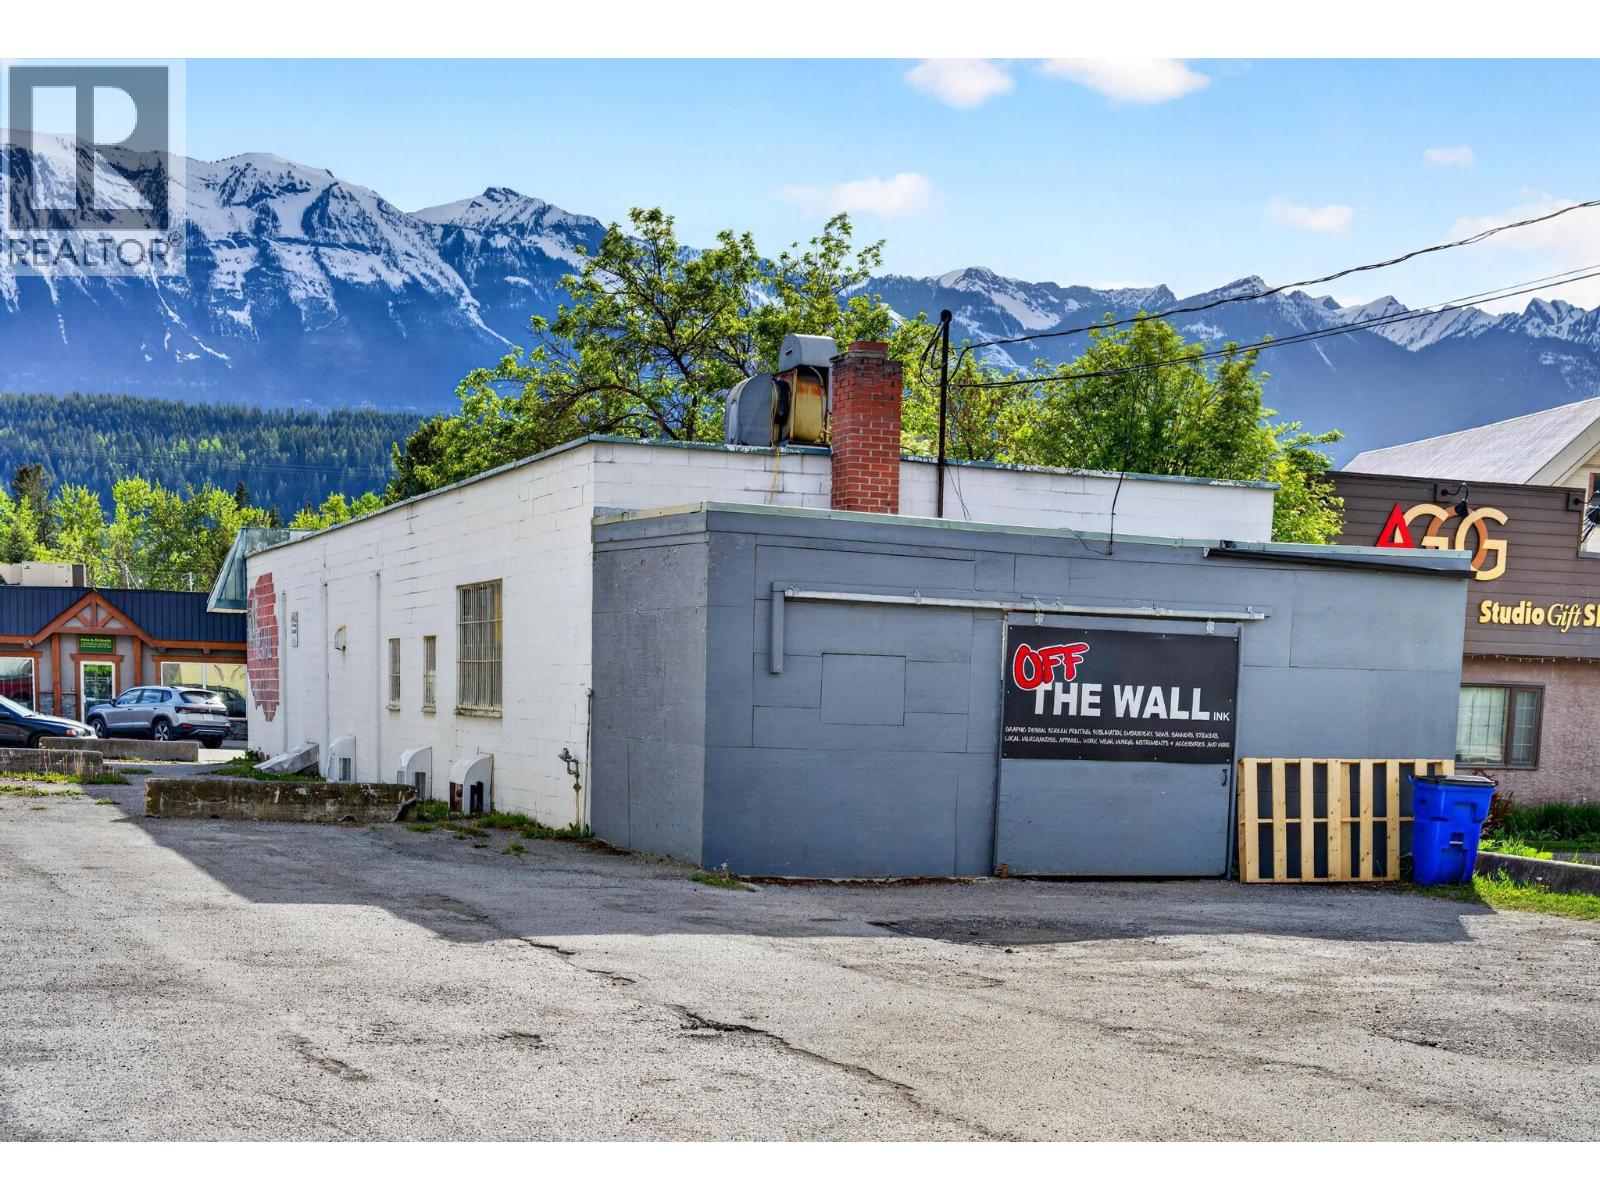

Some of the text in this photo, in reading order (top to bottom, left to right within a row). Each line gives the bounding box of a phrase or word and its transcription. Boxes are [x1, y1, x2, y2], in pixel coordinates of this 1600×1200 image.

[1479, 600, 1545, 626] Studio
[1547, 603, 1584, 633] Gift
[1013, 641, 1090, 692] OFF
[1034, 682, 1230, 722] THE WALL INK
